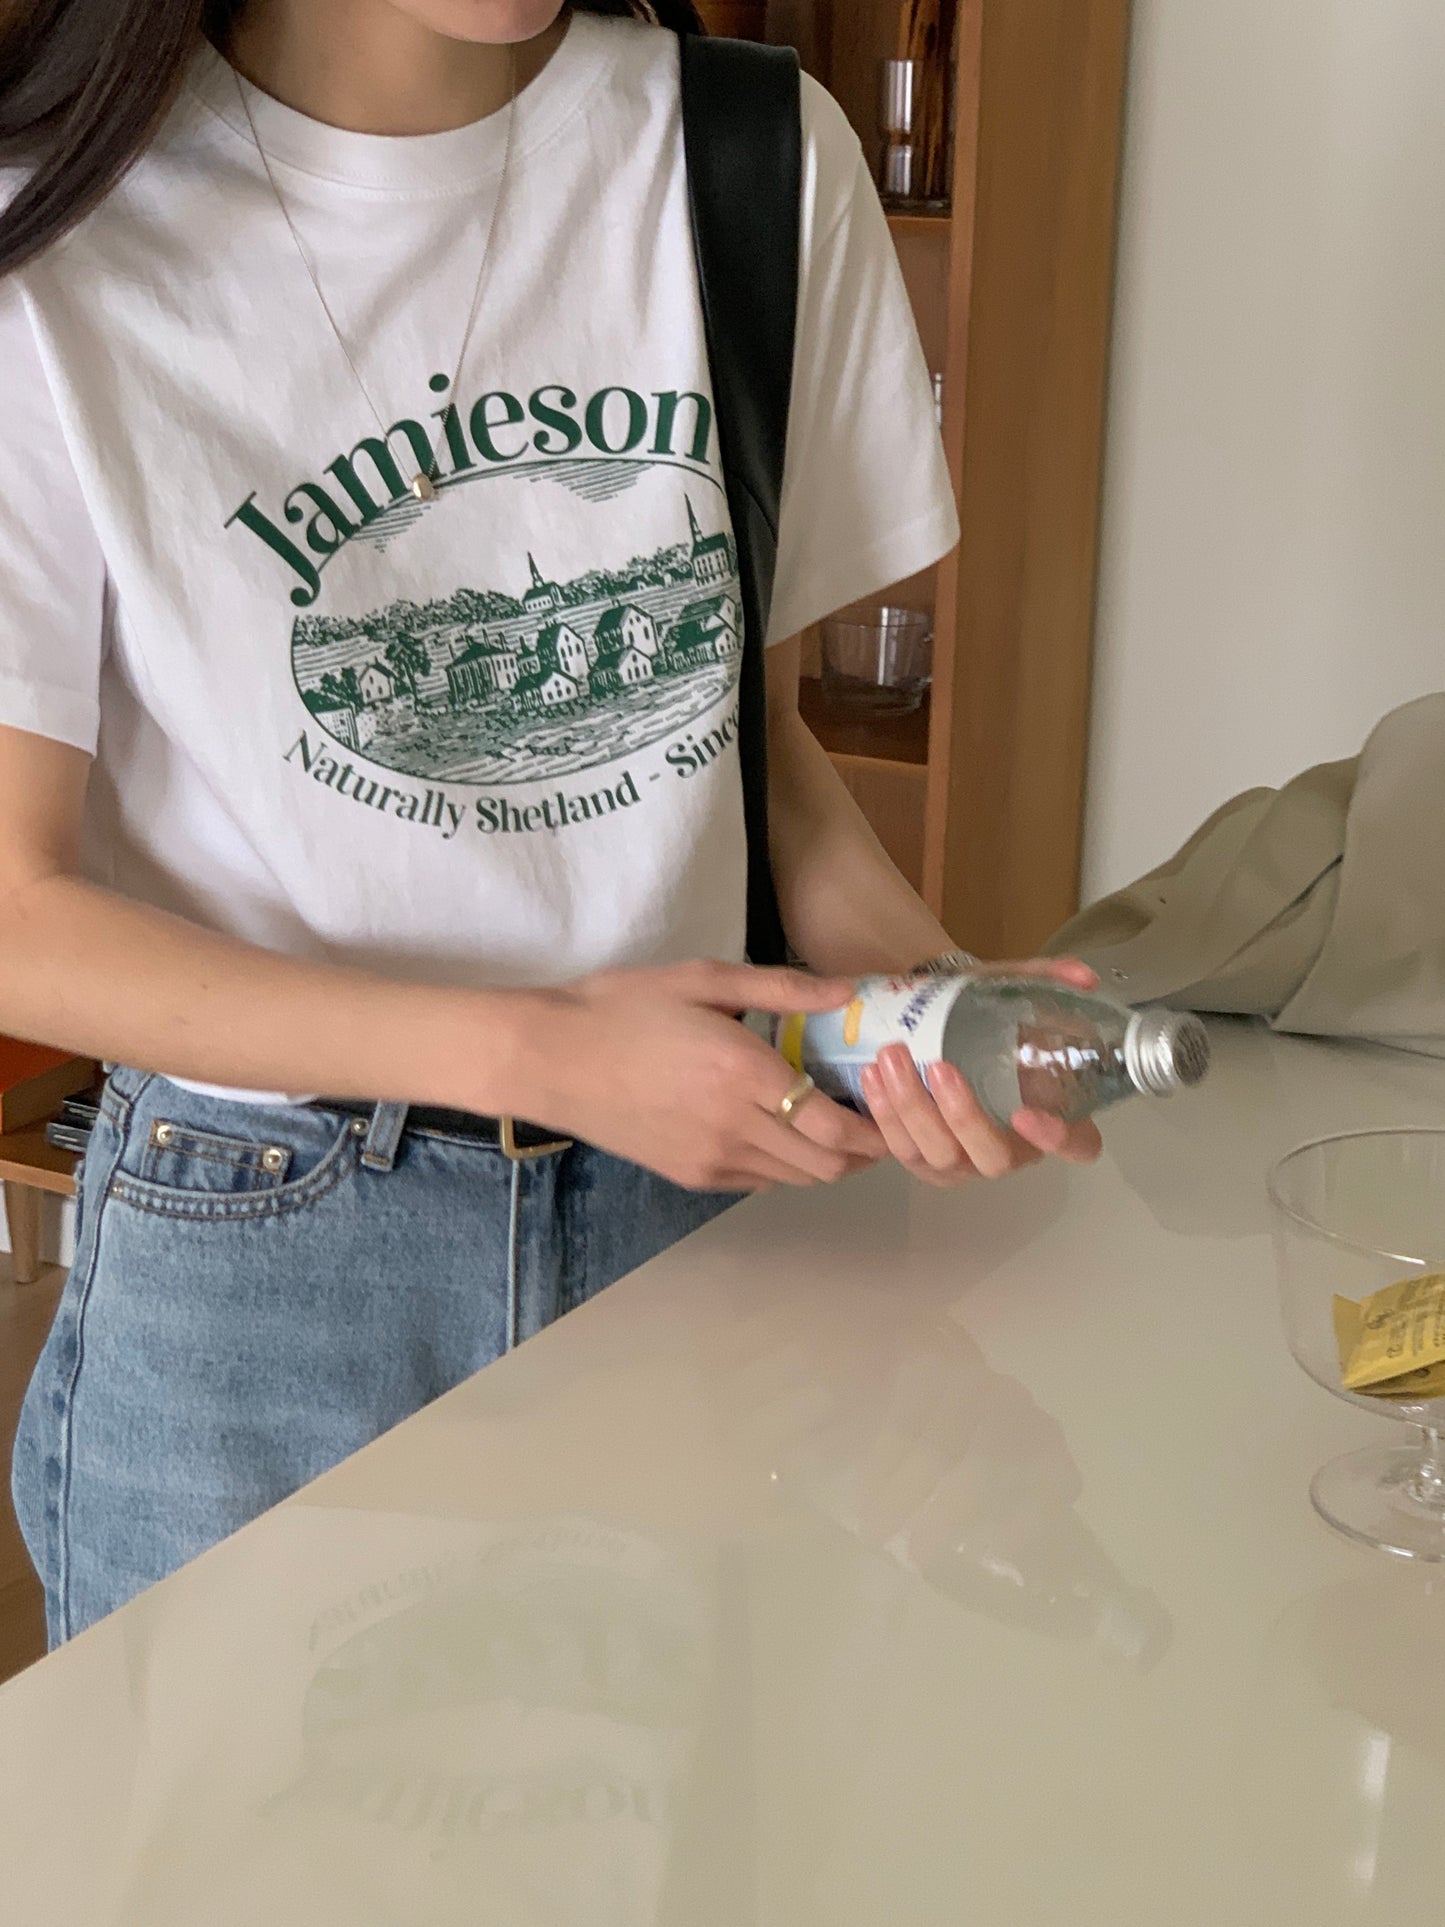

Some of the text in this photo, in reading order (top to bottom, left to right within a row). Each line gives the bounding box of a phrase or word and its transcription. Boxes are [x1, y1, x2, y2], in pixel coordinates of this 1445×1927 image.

[223, 373, 712, 607] Jamieson
[283, 729, 466, 839] Naturally
[476, 769, 642, 834] Shetland
